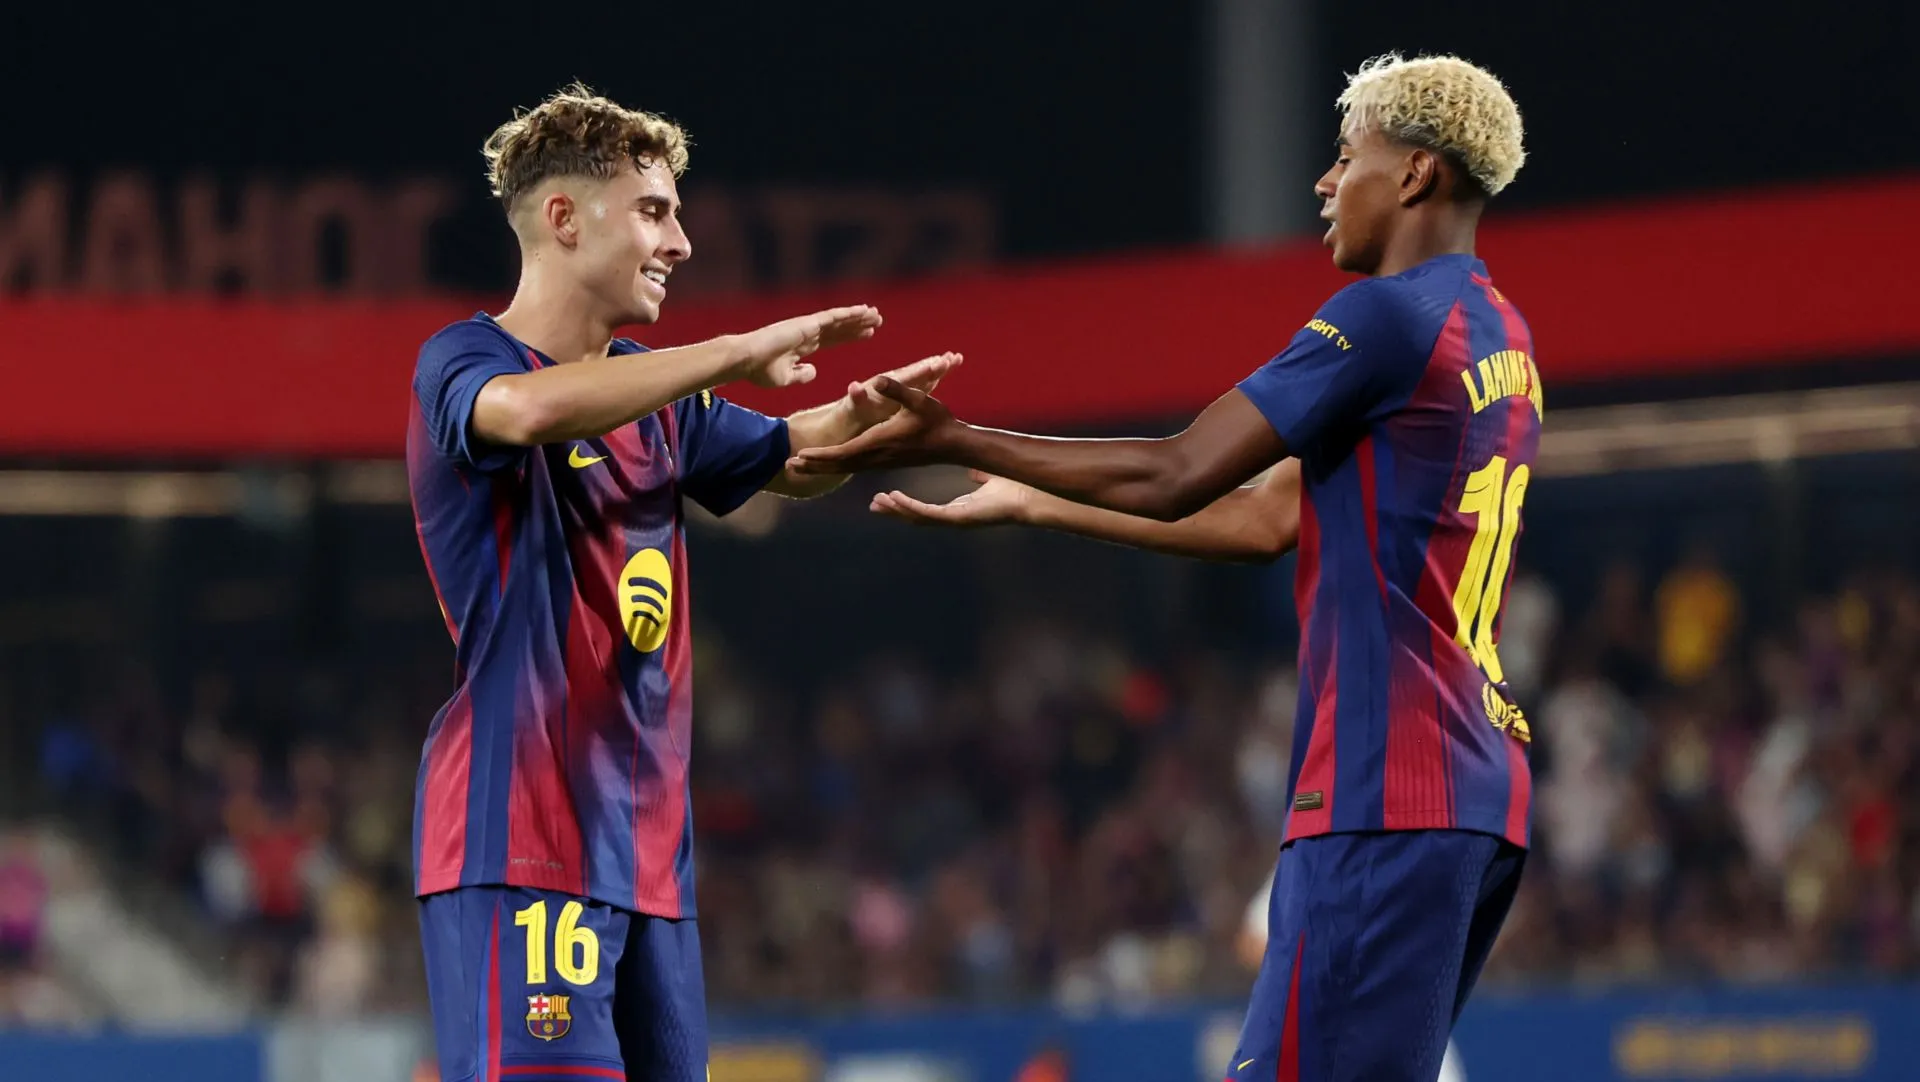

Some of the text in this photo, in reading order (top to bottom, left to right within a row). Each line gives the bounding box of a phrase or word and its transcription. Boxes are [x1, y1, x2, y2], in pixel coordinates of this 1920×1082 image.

[1336, 335, 1352, 350] tv
[1461, 350, 1527, 414] LAMINE
[514, 900, 599, 985] 16
